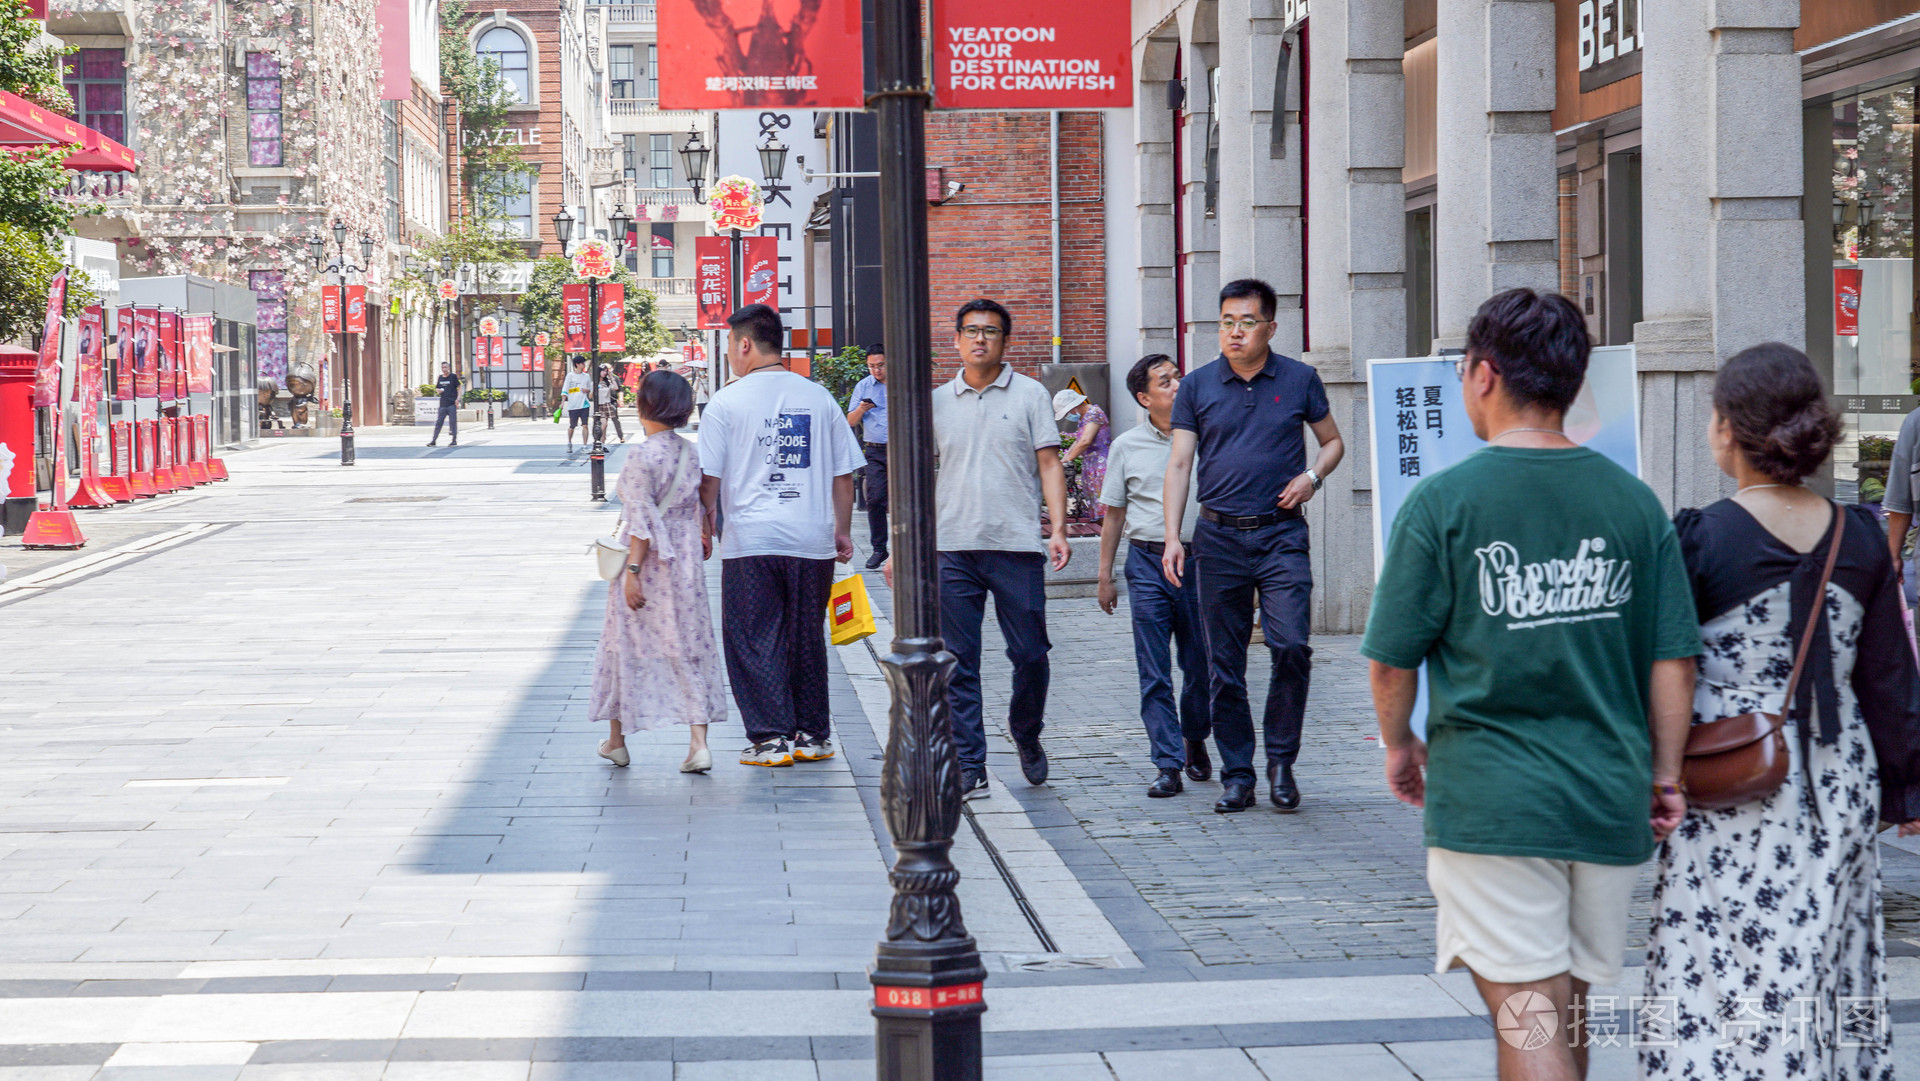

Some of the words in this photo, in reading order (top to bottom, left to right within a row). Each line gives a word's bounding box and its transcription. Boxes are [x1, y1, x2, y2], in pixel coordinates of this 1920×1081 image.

[949, 27, 1055, 42] YEATOON
[949, 43, 1012, 58] YOUR
[950, 59, 1100, 74] DESTINATION
[705, 76, 818, 91] 楚河汉街三街区
[950, 75, 996, 90] FOR
[1000, 75, 1115, 90] CRAWFISH
[759, 112, 791, 137] &
[701, 255, 721, 304] 一棠龙虾
[765, 418, 793, 429] NASA
[1395, 387, 1420, 477] 轻松防晒
[889, 990, 922, 1005] 038
